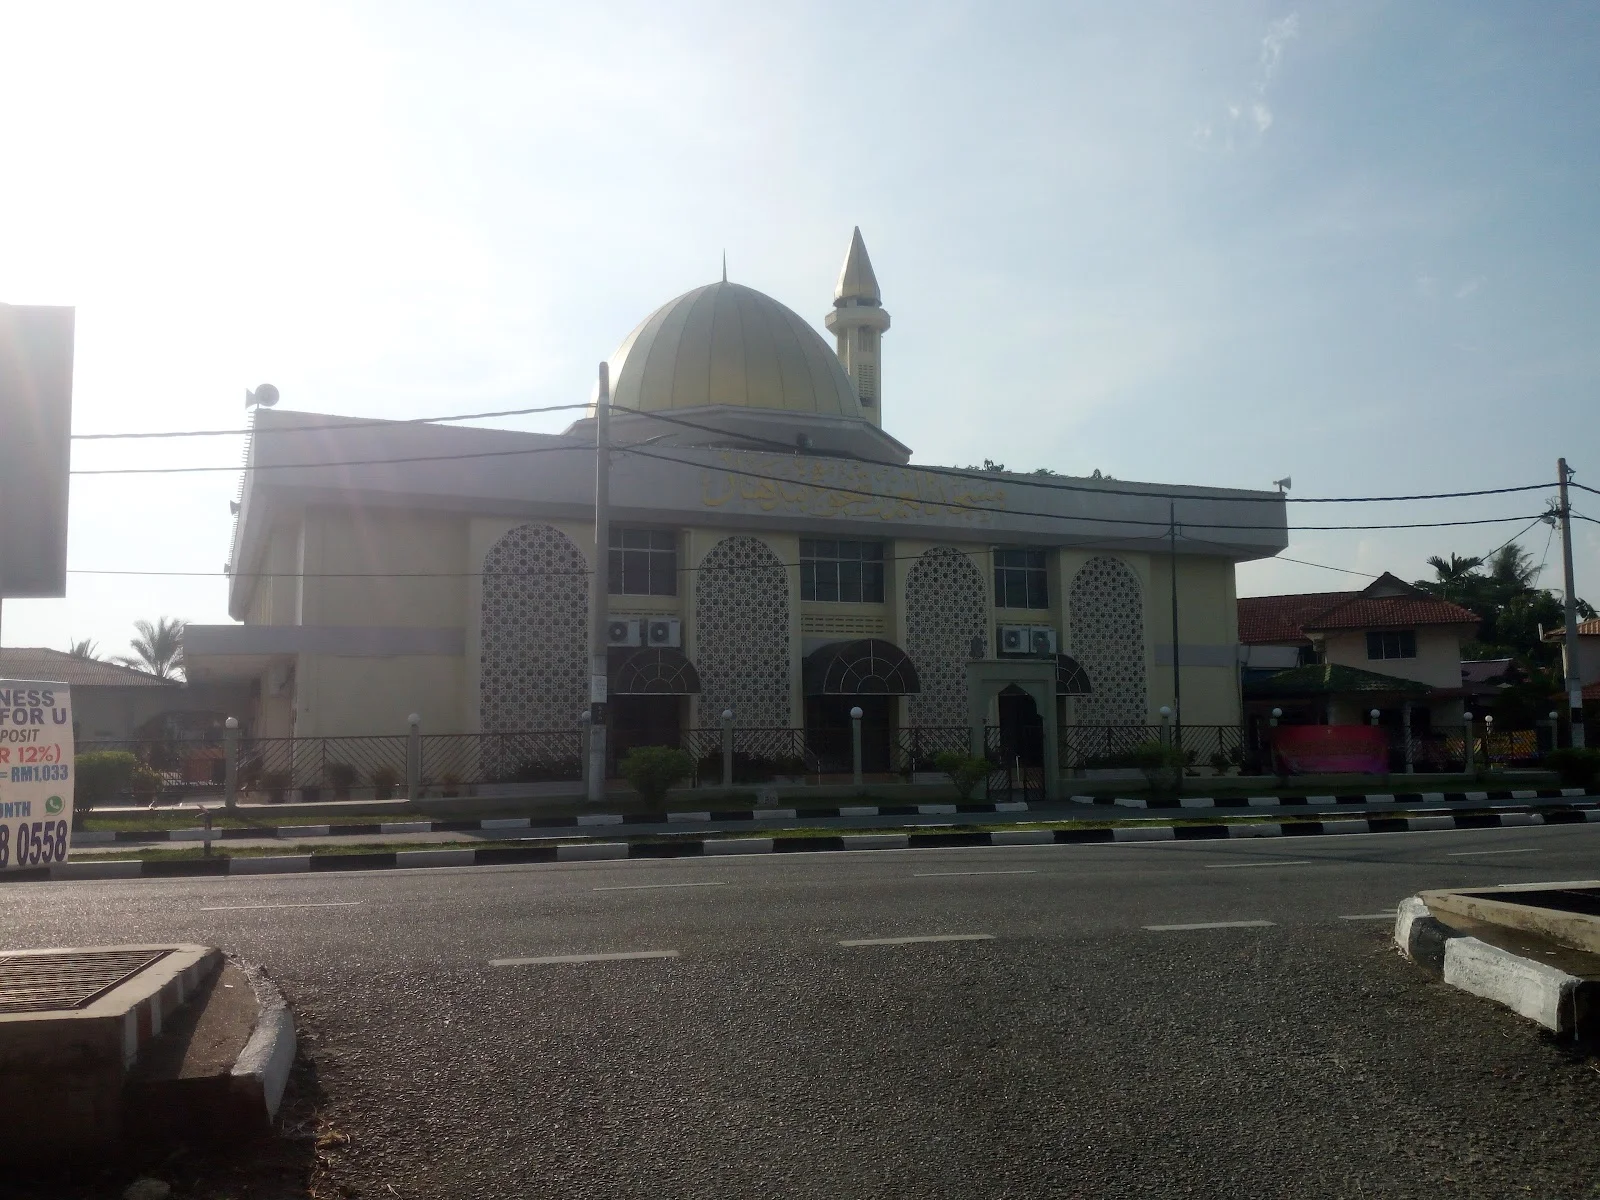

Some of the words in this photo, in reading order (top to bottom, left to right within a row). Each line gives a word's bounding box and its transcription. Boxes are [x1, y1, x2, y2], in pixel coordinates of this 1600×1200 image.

[0, 690, 55, 707] NESS
[0, 708, 45, 725] FOR
[52, 708, 67, 725] U
[0, 729, 40, 742] POSIT
[18, 743, 61, 764] 12%)
[11, 764, 69, 783] RM1,033
[17, 819, 68, 866] 0558
